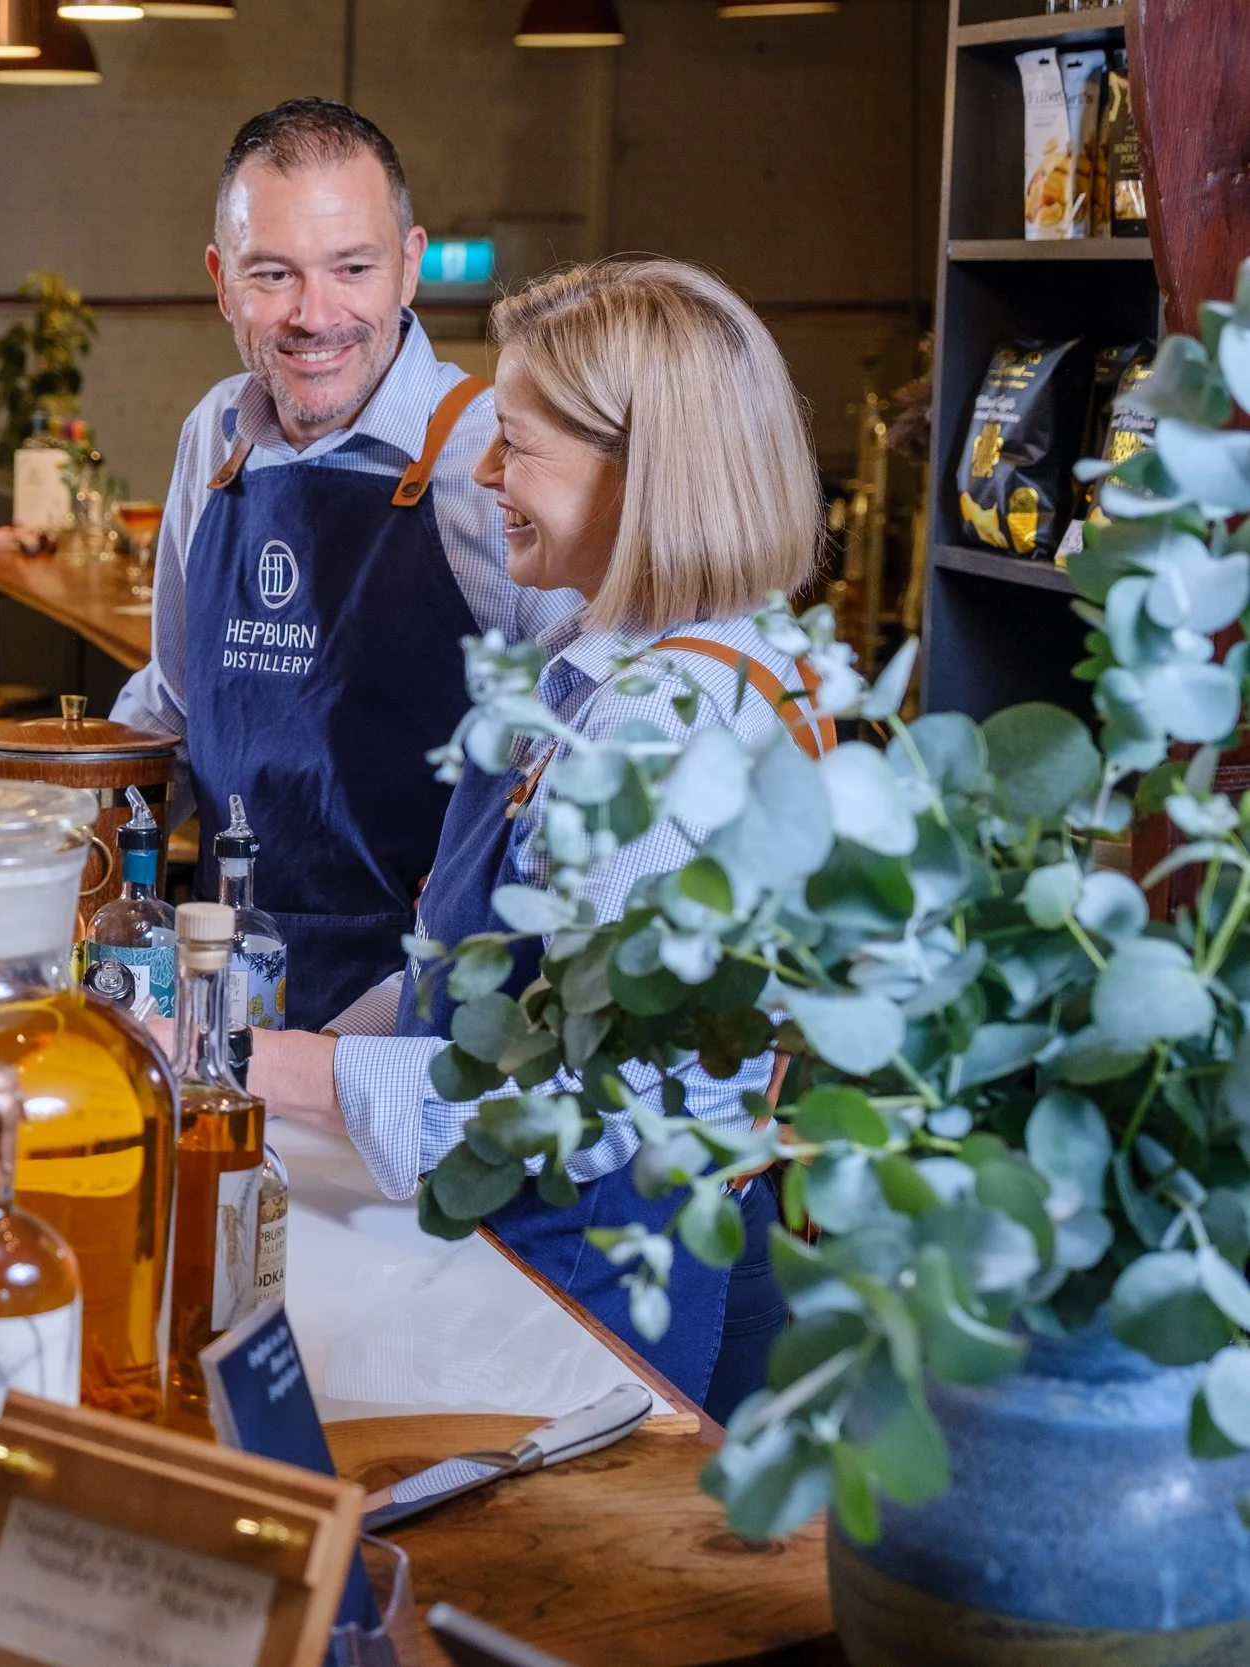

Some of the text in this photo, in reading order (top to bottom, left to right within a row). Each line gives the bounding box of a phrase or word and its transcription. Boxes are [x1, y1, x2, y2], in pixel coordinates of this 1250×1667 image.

[225, 618, 317, 649] HEPBURN
[222, 649, 314, 675] DISTILLERY
[257, 1268, 285, 1288] DKA
